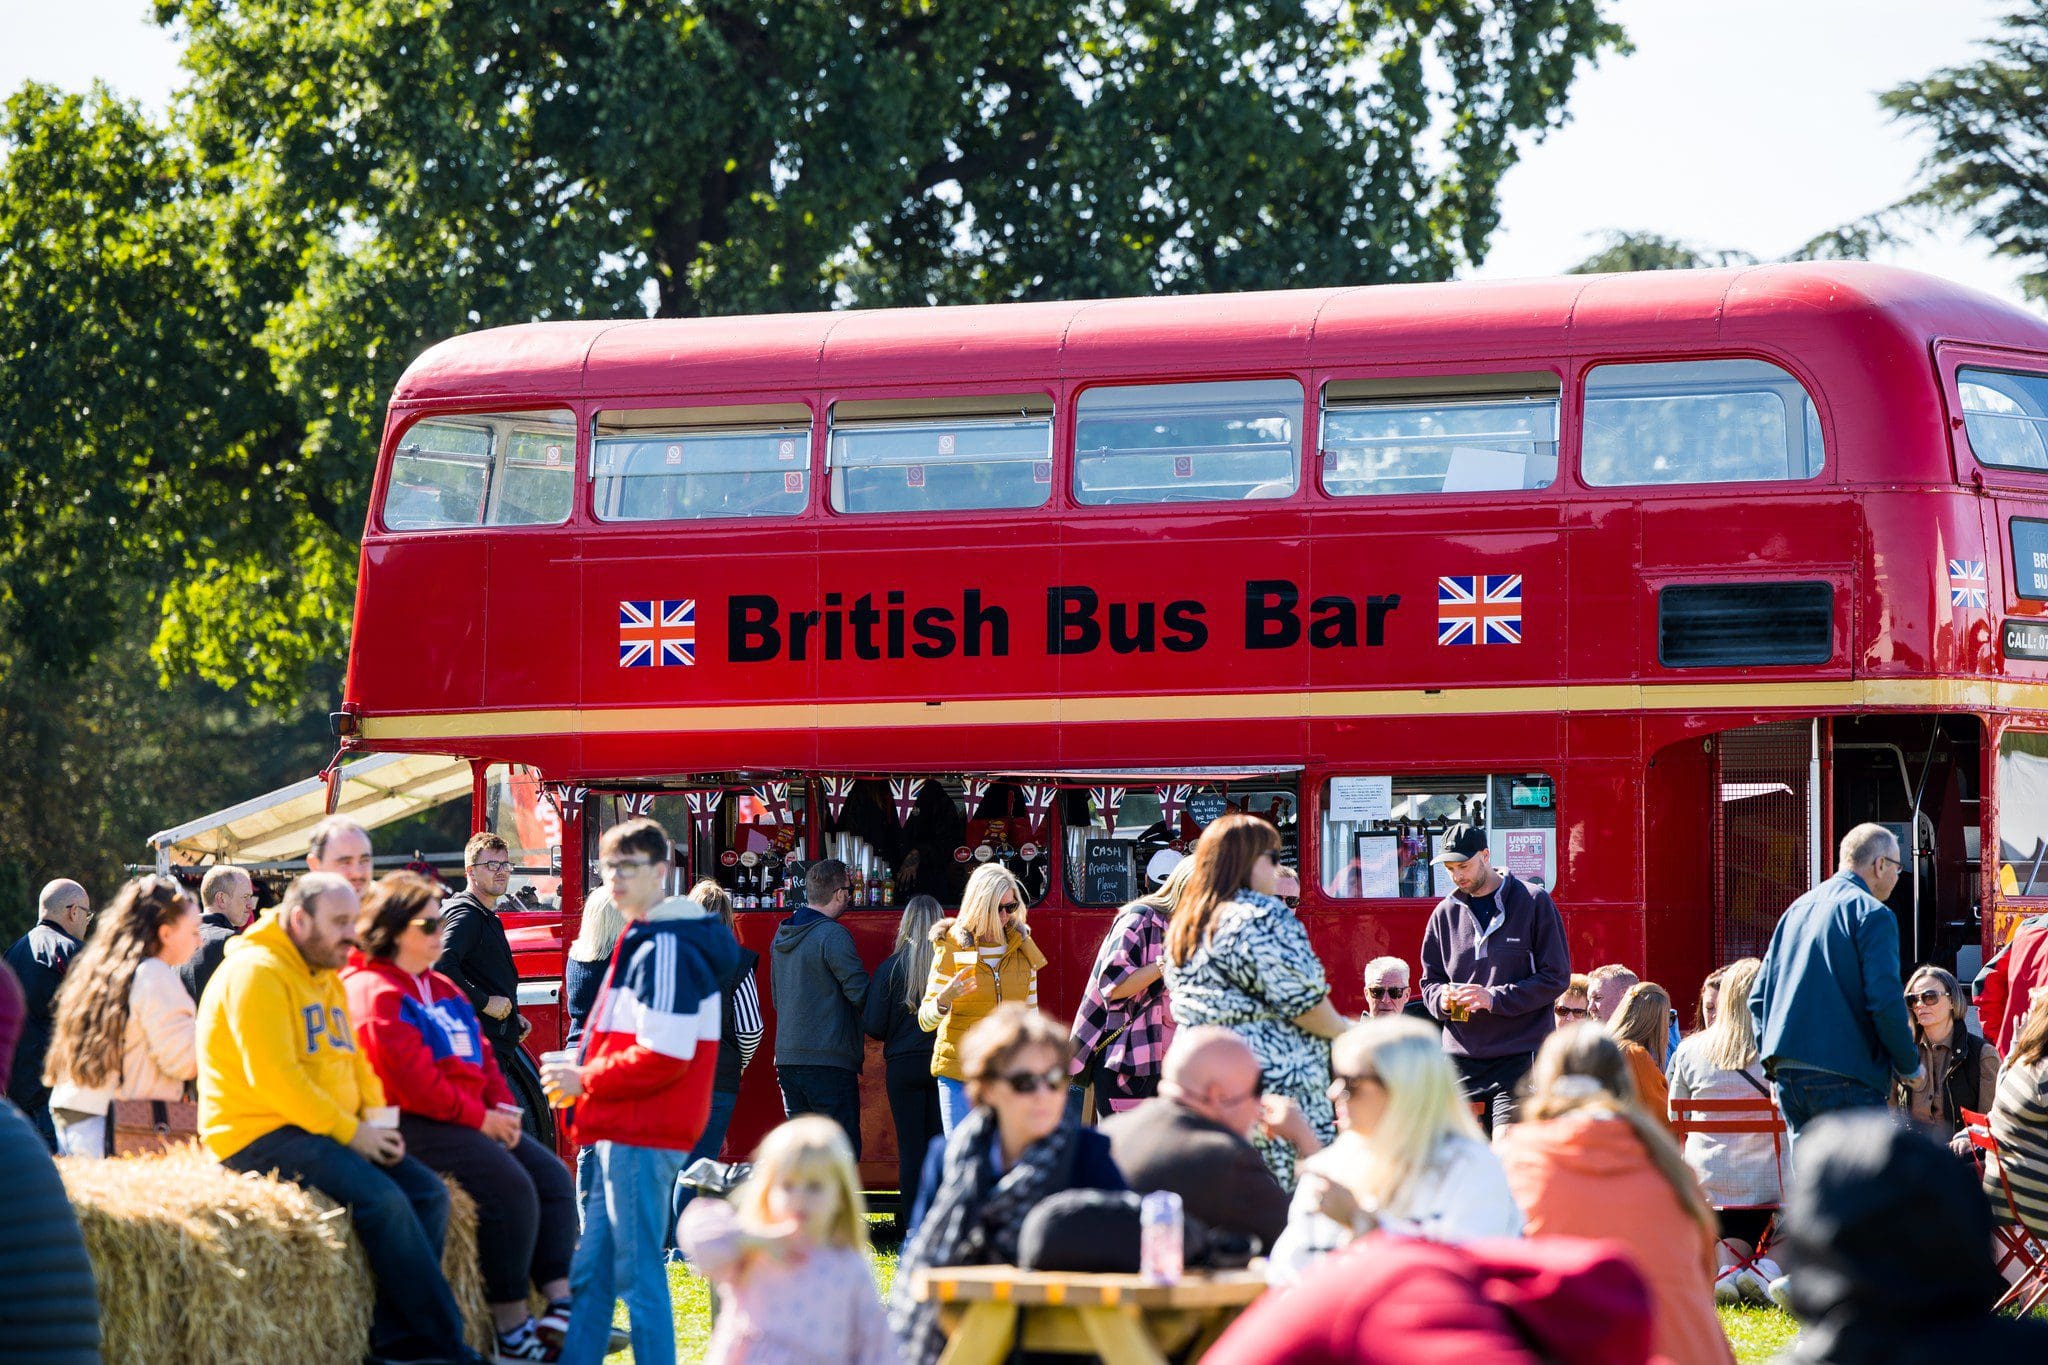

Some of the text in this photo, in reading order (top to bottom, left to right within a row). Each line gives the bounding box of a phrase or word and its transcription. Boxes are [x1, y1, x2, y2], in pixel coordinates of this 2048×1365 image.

[727, 579, 1402, 663] British Bus Bar
[2007, 631, 2036, 649] CALL:
[1508, 835, 1543, 844] UNDER
[1092, 845, 1121, 858] CASH
[1508, 844, 1526, 853] 25?
